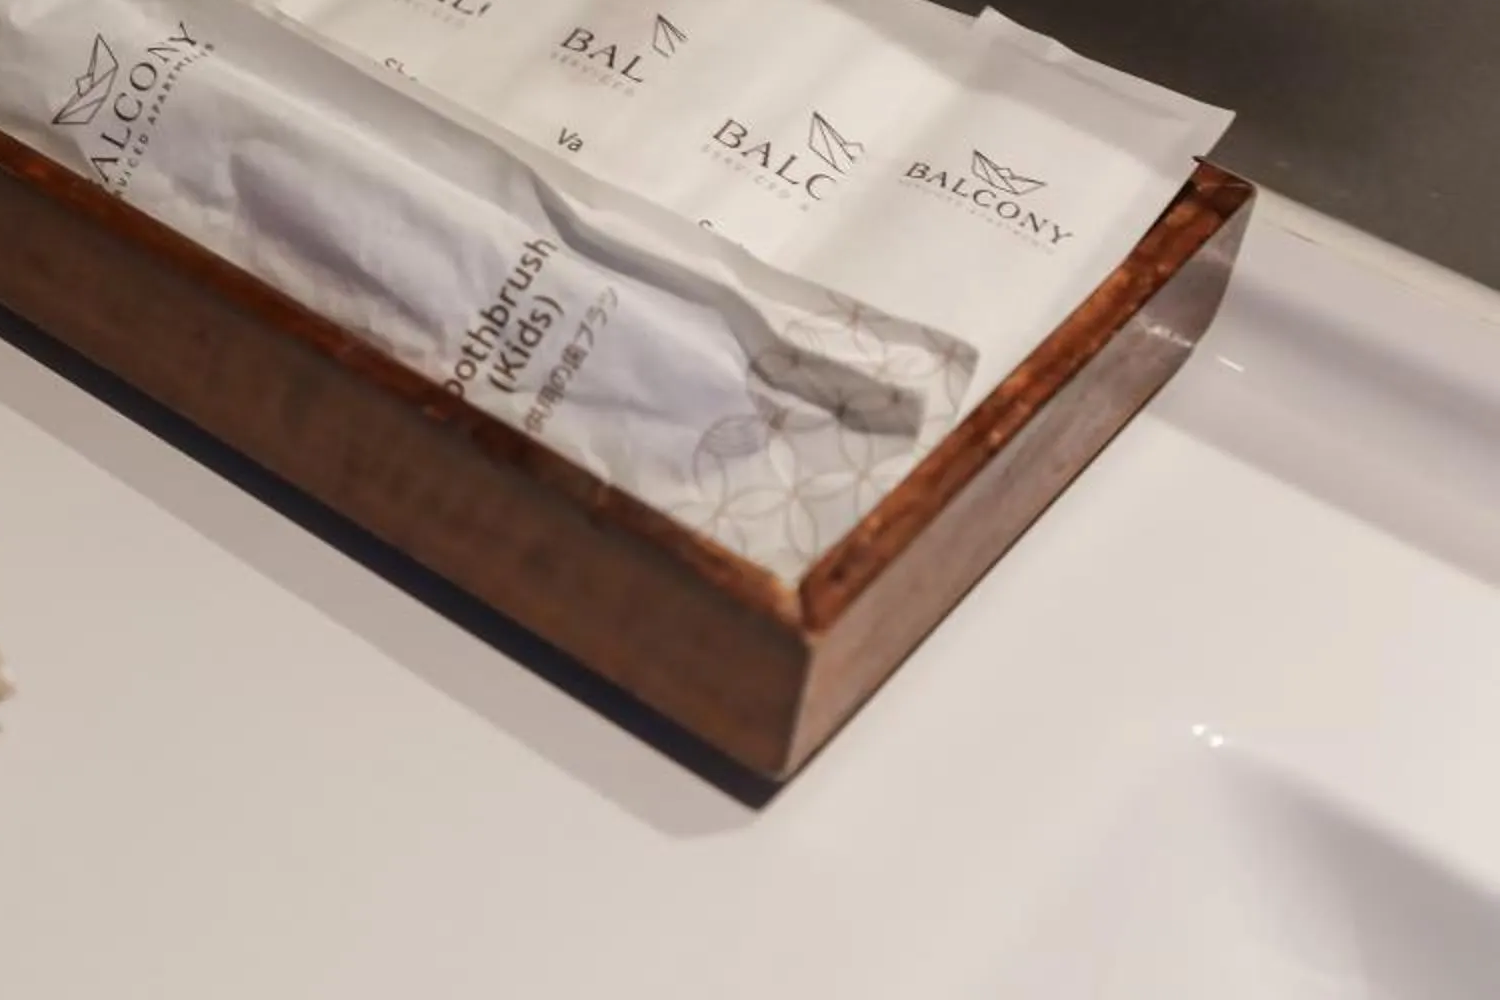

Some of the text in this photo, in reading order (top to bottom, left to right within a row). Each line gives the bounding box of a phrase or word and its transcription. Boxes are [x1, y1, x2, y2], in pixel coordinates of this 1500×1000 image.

[712, 118, 838, 202] BALC
[904, 161, 1074, 245] BALCONY
[487, 294, 566, 395] (Kids)
